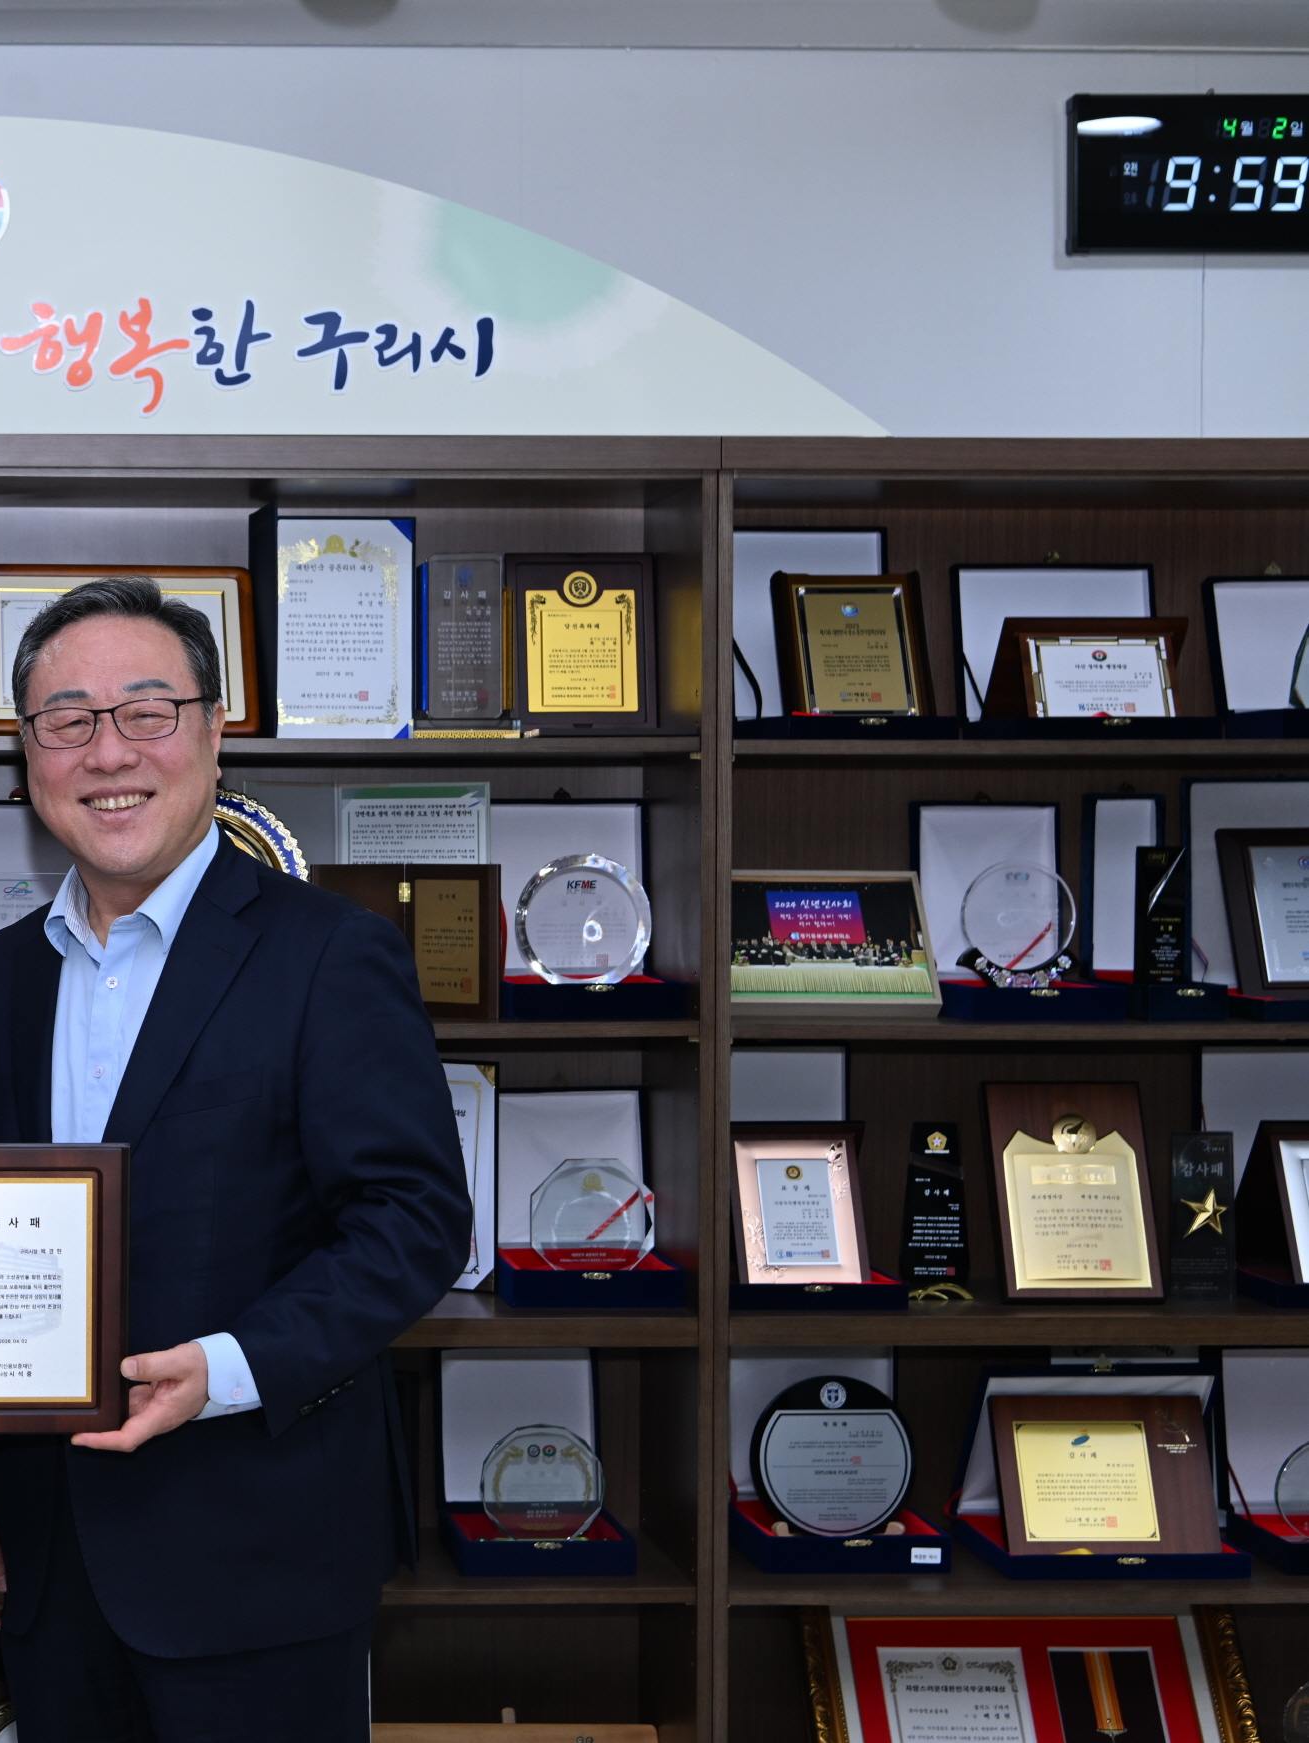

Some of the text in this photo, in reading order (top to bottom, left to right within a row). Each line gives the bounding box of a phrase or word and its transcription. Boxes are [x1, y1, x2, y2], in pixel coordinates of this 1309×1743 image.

[0, 297, 271, 414] 행복한
[297, 311, 492, 389] 구리시
[296, 564, 374, 572] 대한민국 골든리더 대상
[567, 880, 597, 889] KFME
[775, 899, 852, 909] 2024 신년인사회
[1182, 1162, 1224, 1177] 감사패
